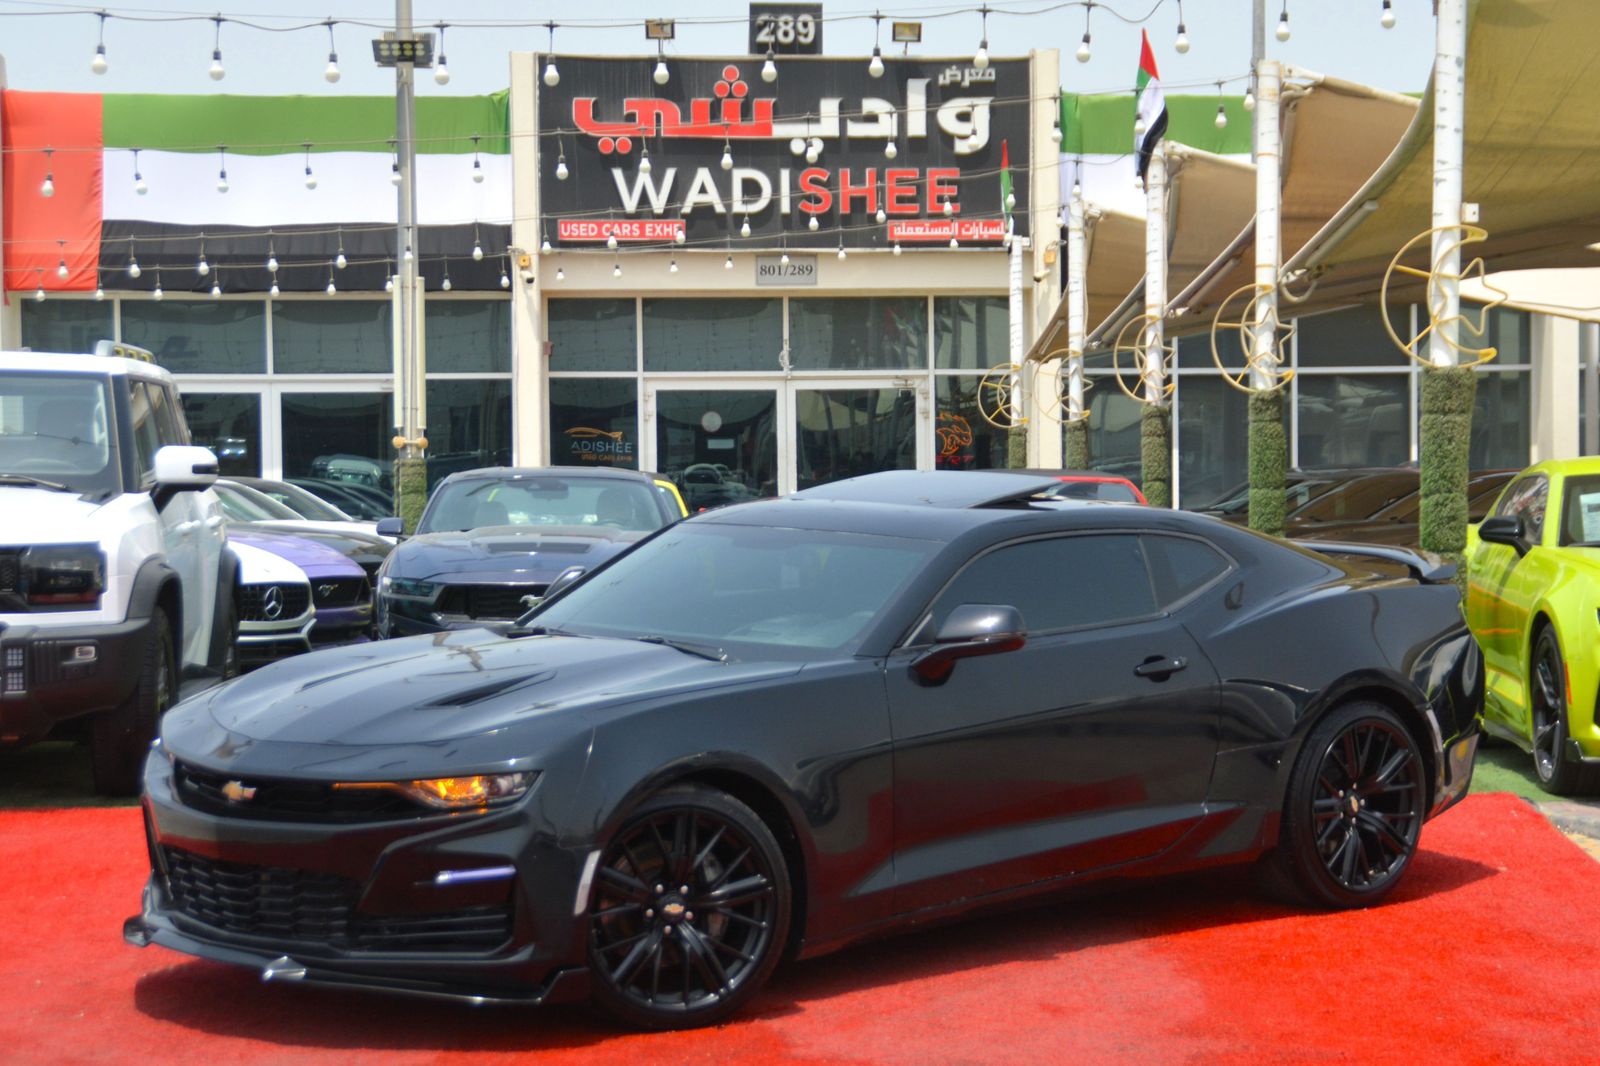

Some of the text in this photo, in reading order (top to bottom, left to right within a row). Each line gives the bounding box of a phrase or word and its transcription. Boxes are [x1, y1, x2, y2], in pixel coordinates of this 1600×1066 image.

[755, 13, 816, 45] 289
[938, 65, 996, 88] معرض
[611, 167, 962, 215] WADISHEE
[561, 223, 598, 236] USED
[602, 223, 640, 236] CARS
[759, 264, 813, 276] 801/289
